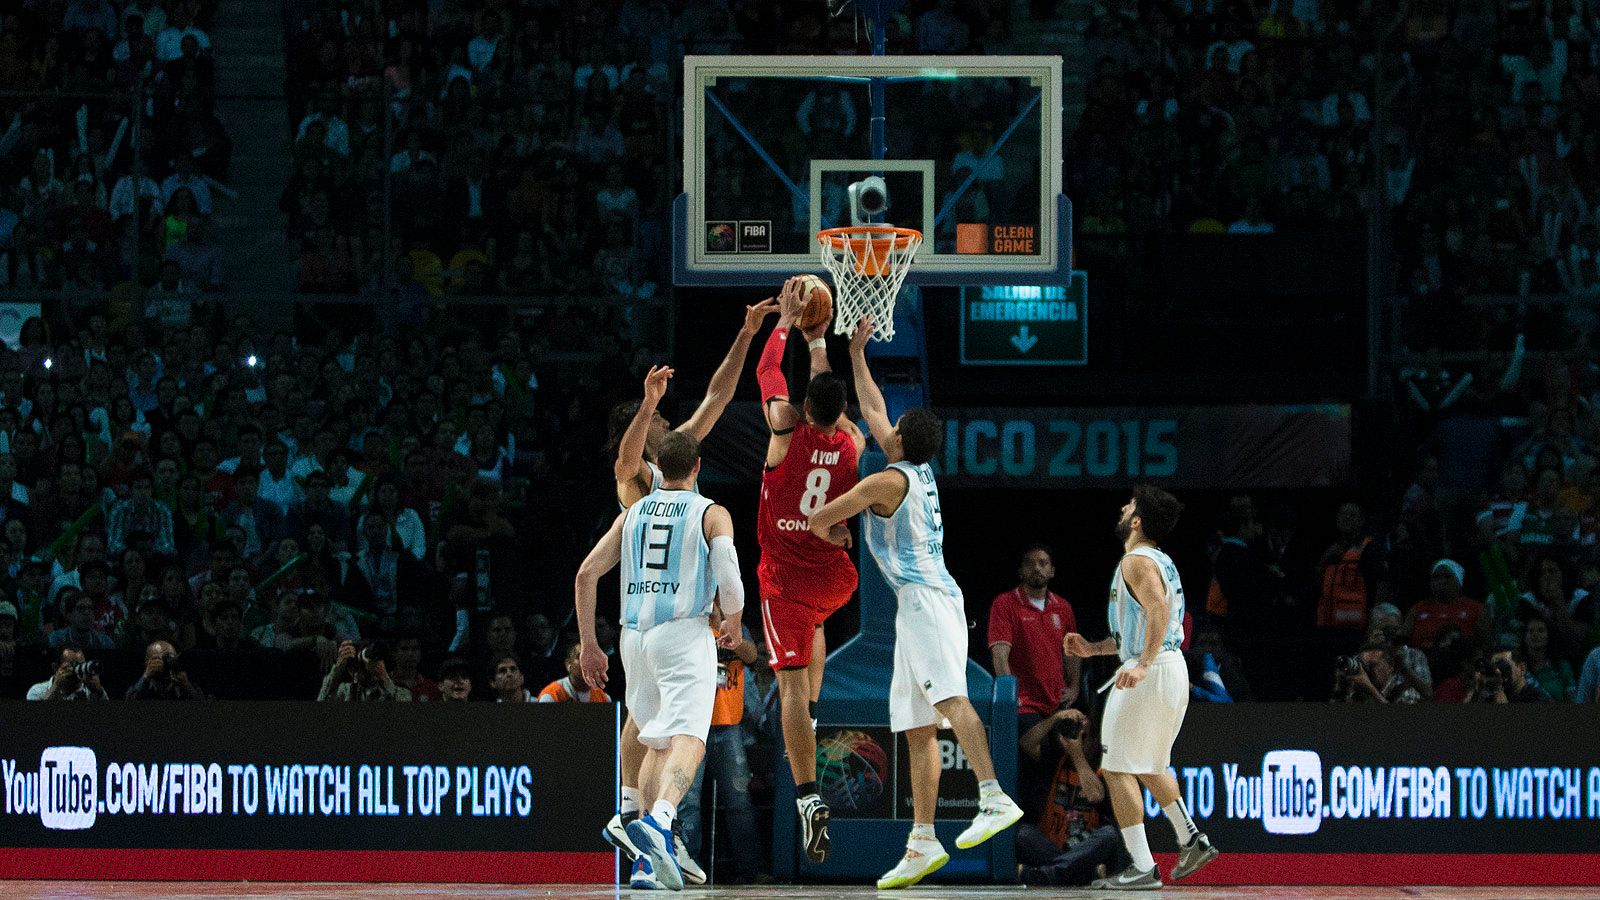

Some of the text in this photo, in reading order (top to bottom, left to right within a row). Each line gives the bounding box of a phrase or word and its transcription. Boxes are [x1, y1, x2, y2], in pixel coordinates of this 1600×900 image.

[744, 226, 766, 236] FIBA
[994, 226, 1034, 239] CLEAN
[994, 240, 1034, 253] GAME
[970, 302, 1078, 320] EMERGENCIA
[930, 418, 1178, 477] ICO 2015
[810, 449, 840, 465] AYON
[800, 468, 831, 517] 8
[639, 501, 687, 518] NOCIONI
[640, 522, 674, 570] 13
[627, 581, 681, 595] DIRECTV
[938, 740, 973, 770] BA
[227, 764, 259, 815] TO
[264, 764, 351, 815] WATCH
[358, 764, 400, 816] ALL
[403, 764, 451, 816] TOP
[456, 764, 533, 816] PLAYS
[1182, 766, 1214, 818] TO
[1454, 767, 1488, 818] TO
[1492, 767, 1581, 818] WATCH
